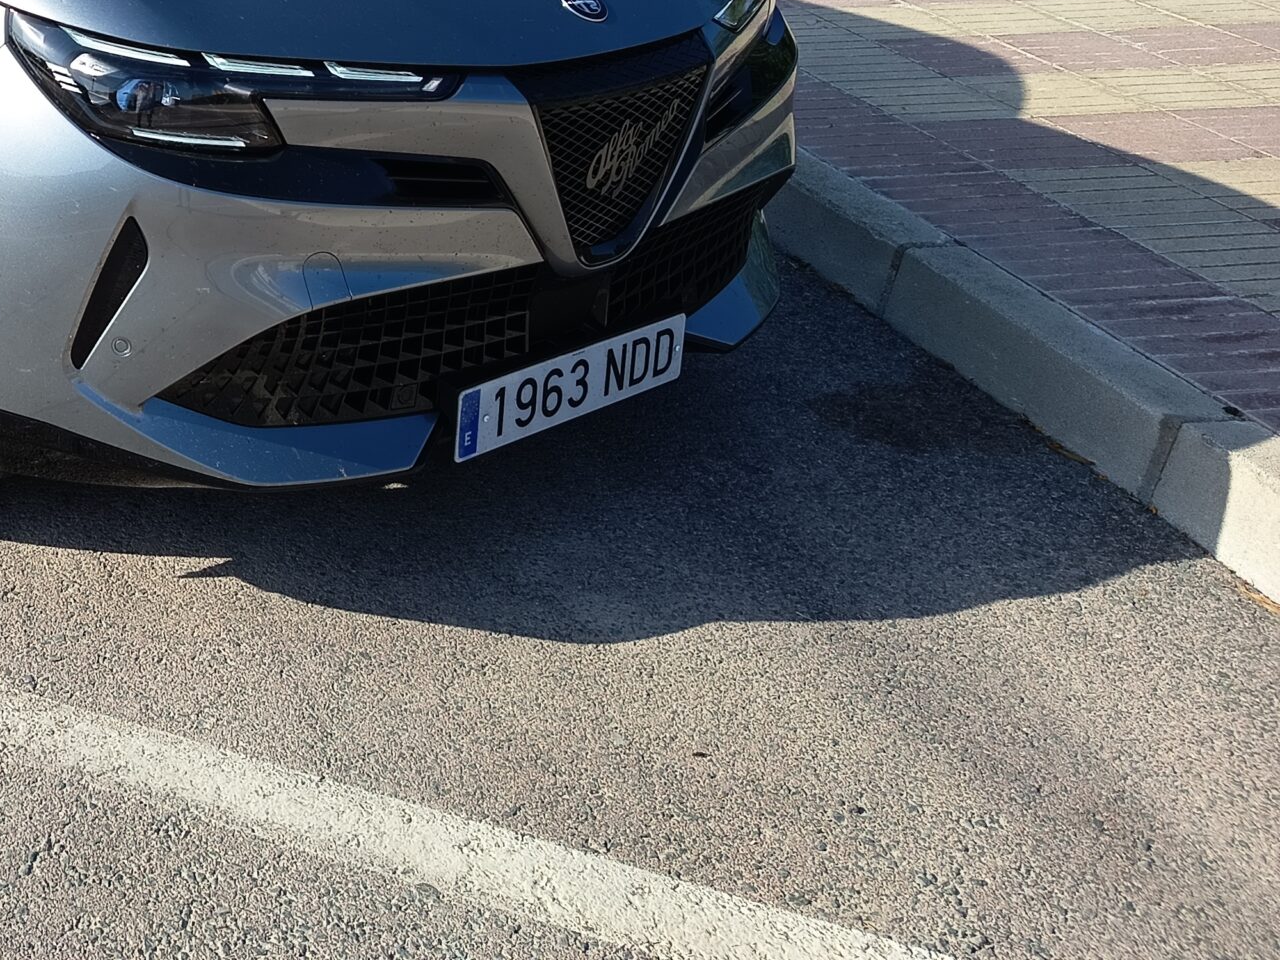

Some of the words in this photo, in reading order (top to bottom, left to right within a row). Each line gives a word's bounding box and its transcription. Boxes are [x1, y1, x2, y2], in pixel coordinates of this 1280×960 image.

[586, 118, 643, 195] Alfa
[612, 98, 680, 199] Romeo
[494, 358, 590, 437] 1963
[603, 327, 675, 396] NDD
[464, 431, 472, 446] E
